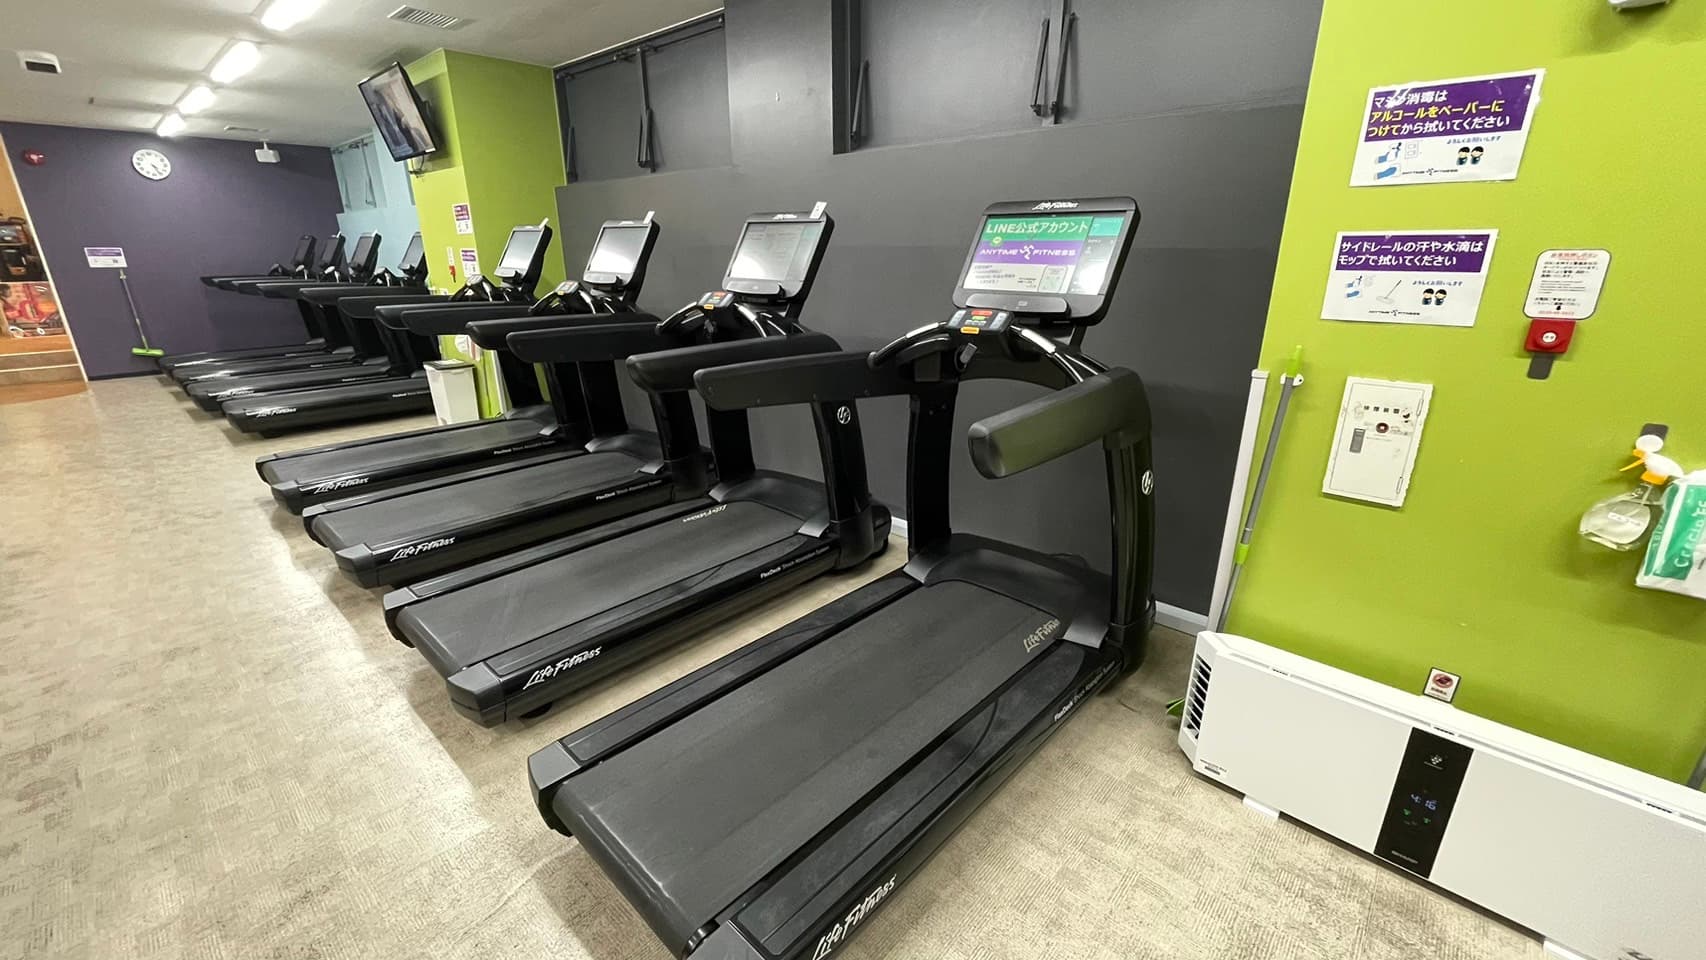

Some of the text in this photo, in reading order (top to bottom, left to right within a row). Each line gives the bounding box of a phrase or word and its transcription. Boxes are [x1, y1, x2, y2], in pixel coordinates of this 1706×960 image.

[1370, 100, 1505, 123] アルコールをペーパーに
[1368, 116, 1510, 137] つけてから拭いてください
[985, 220, 1089, 234] LINE公式アカウント
[979, 248, 1077, 257] ANYTIME FITNESS
[1341, 241, 1484, 253] サイドレールの汗や水滴は
[1338, 254, 1457, 267] モップで拭いてください
